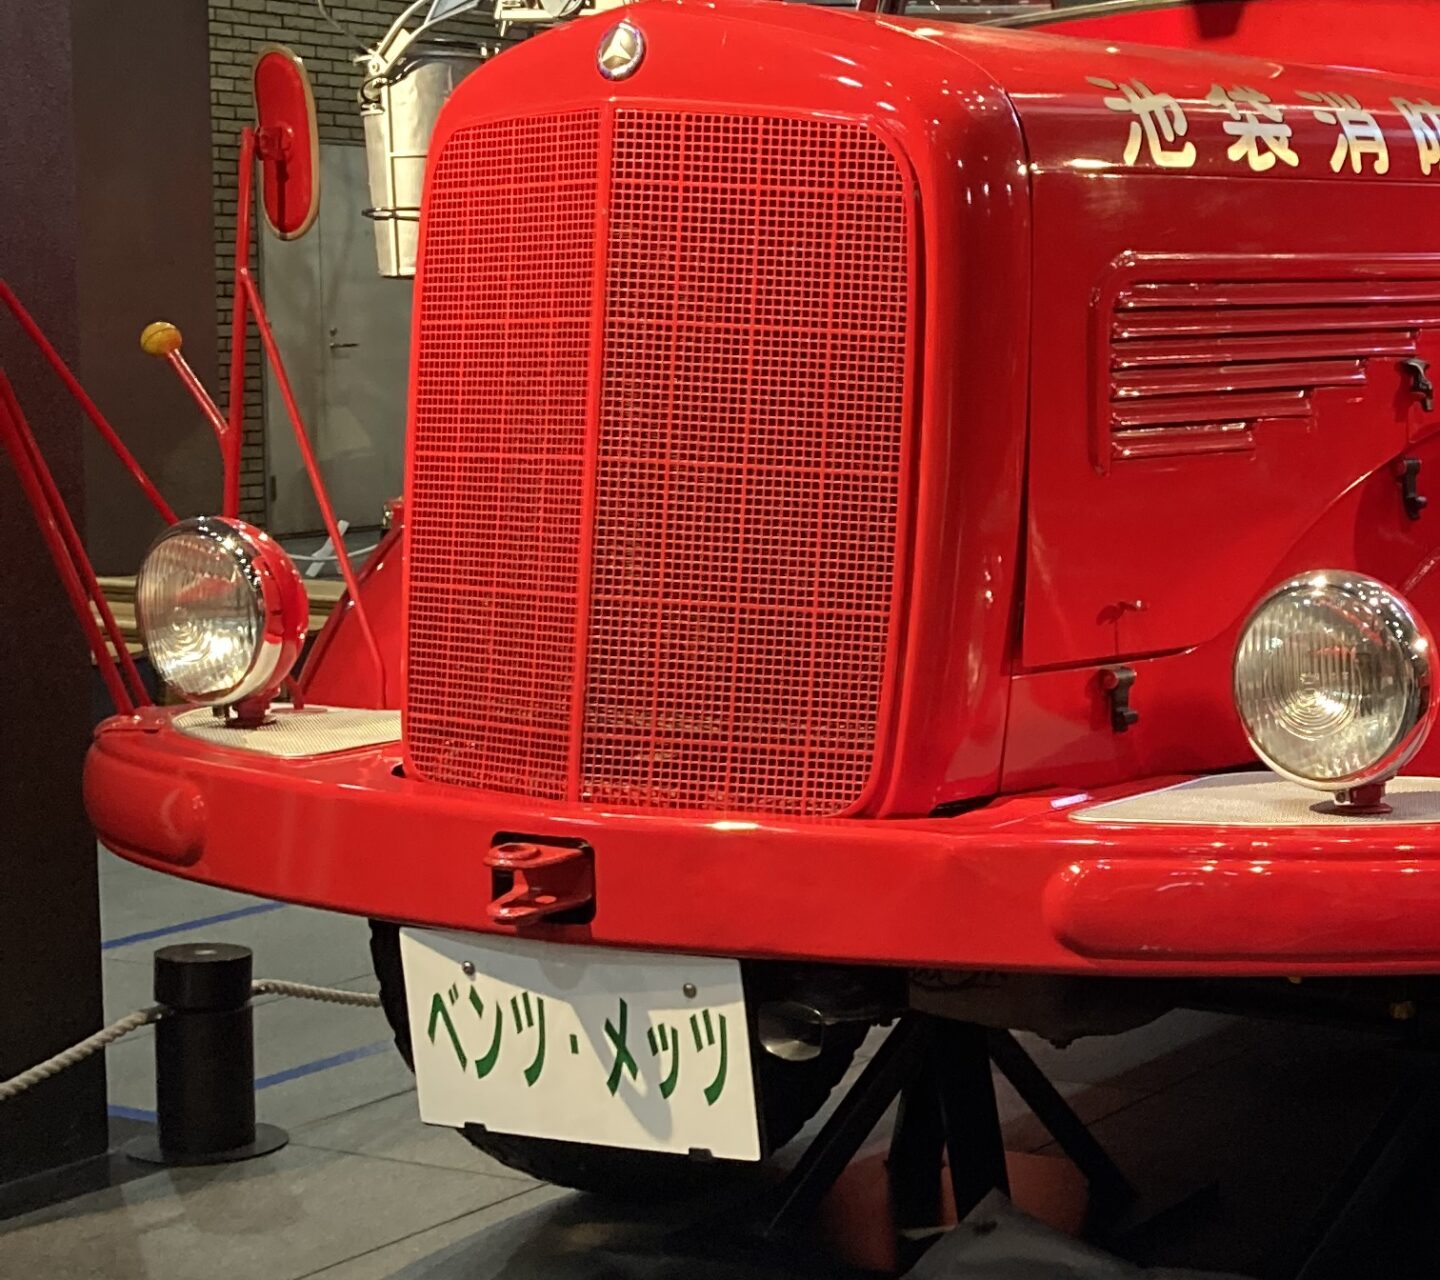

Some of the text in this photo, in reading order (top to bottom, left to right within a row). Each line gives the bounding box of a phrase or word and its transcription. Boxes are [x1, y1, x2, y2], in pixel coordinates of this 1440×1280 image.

[427, 983, 727, 1106] ベンツ・メッツ
